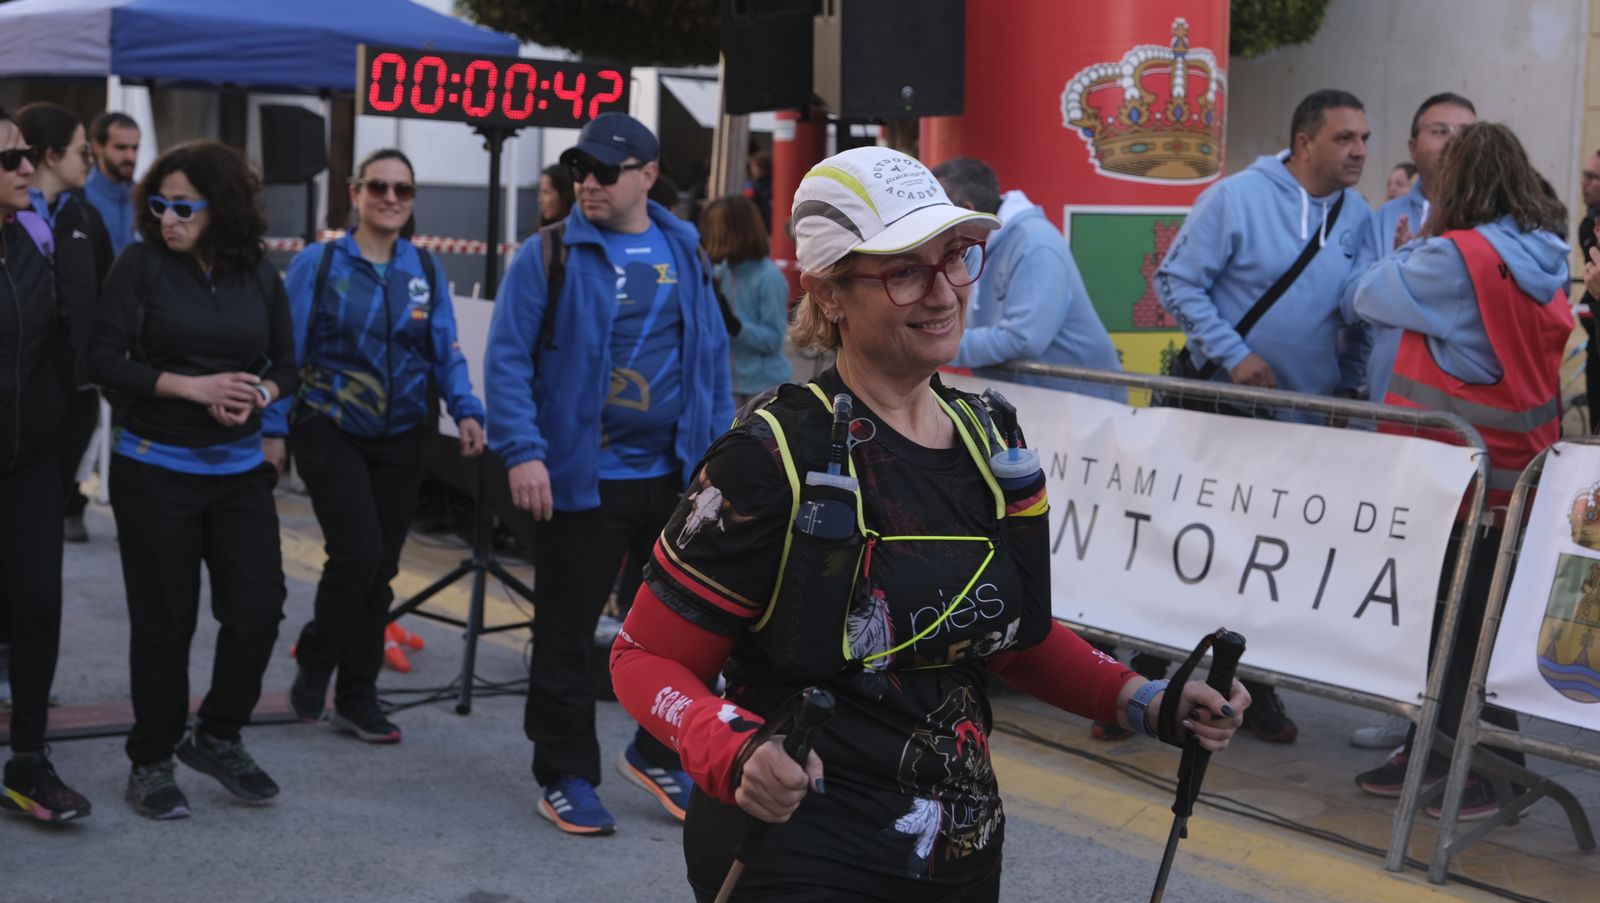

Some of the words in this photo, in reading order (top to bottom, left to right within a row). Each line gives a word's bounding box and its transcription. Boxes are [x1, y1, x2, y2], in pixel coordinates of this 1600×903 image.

[368, 52, 624, 120] 00:00:42
[1048, 451, 1327, 525] NTAMIENTO
[1352, 500, 1411, 540] DE
[1050, 498, 1401, 627] NTORIA
[909, 582, 1005, 652] pies
